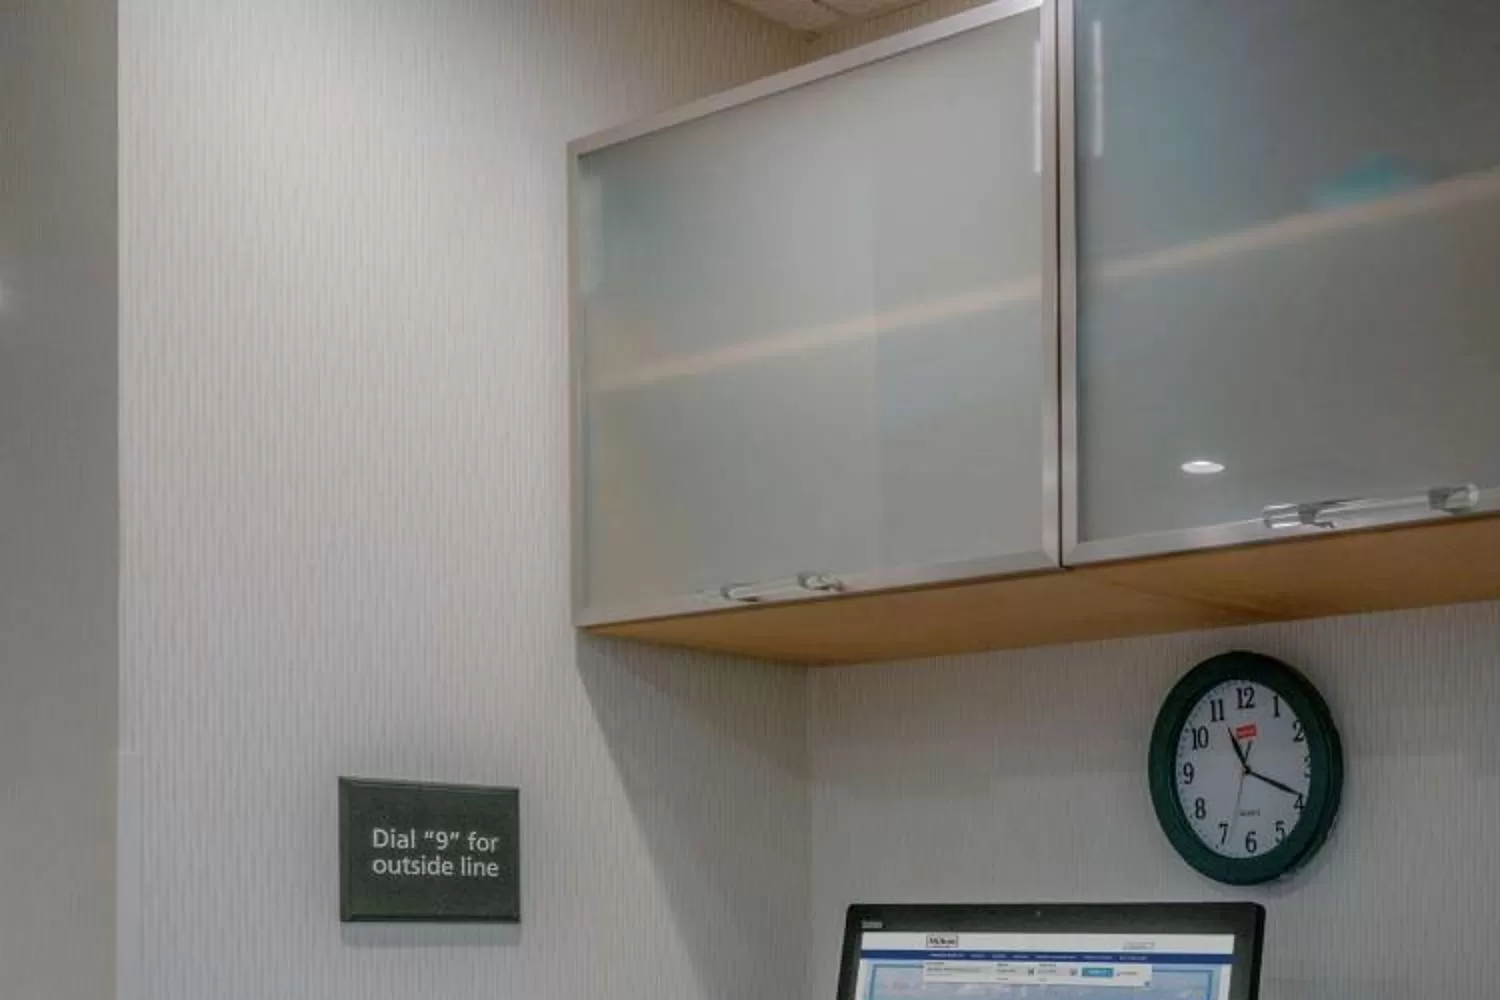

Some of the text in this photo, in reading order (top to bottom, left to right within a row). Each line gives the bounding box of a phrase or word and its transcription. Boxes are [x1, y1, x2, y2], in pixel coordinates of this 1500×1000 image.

[1236, 687, 1255, 709] 12
[1272, 695, 1280, 718] 1
[1210, 699, 1225, 722] 11
[1192, 726, 1209, 750] 10
[1292, 720, 1305, 743] 2
[1183, 762, 1195, 785] 9
[1194, 797, 1206, 819] 8
[1293, 793, 1305, 814] 4
[372, 827, 416, 849] Dial
[467, 831, 500, 852] for
[1218, 823, 1229, 846] 7
[1245, 831, 1257, 854] 6
[1275, 820, 1287, 843] 5
[371, 855, 500, 877] outside line
